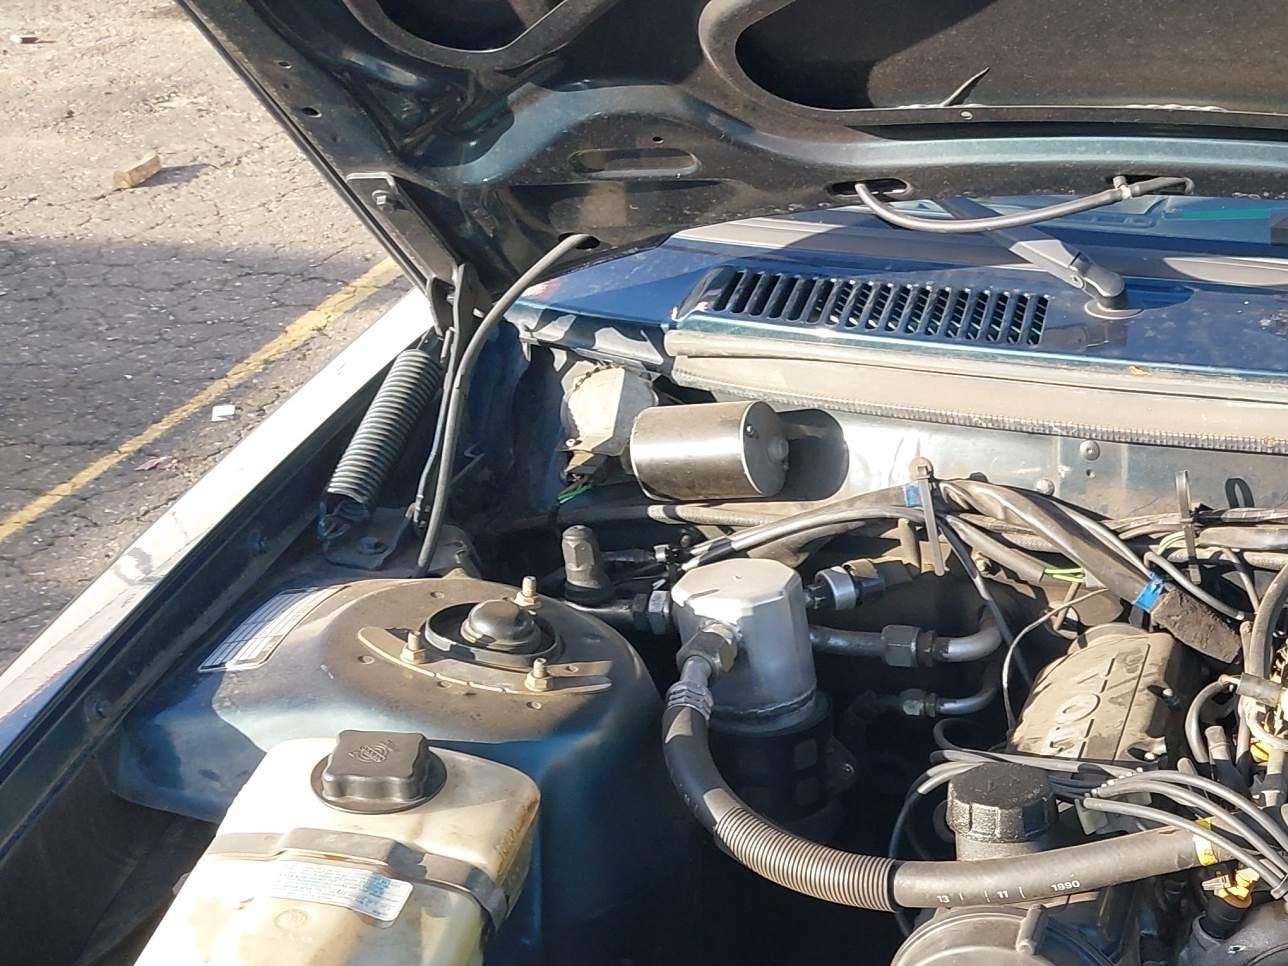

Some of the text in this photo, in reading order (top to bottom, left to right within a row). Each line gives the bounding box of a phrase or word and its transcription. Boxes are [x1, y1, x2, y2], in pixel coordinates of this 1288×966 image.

[936, 880, 1081, 903] 13 11 1990
